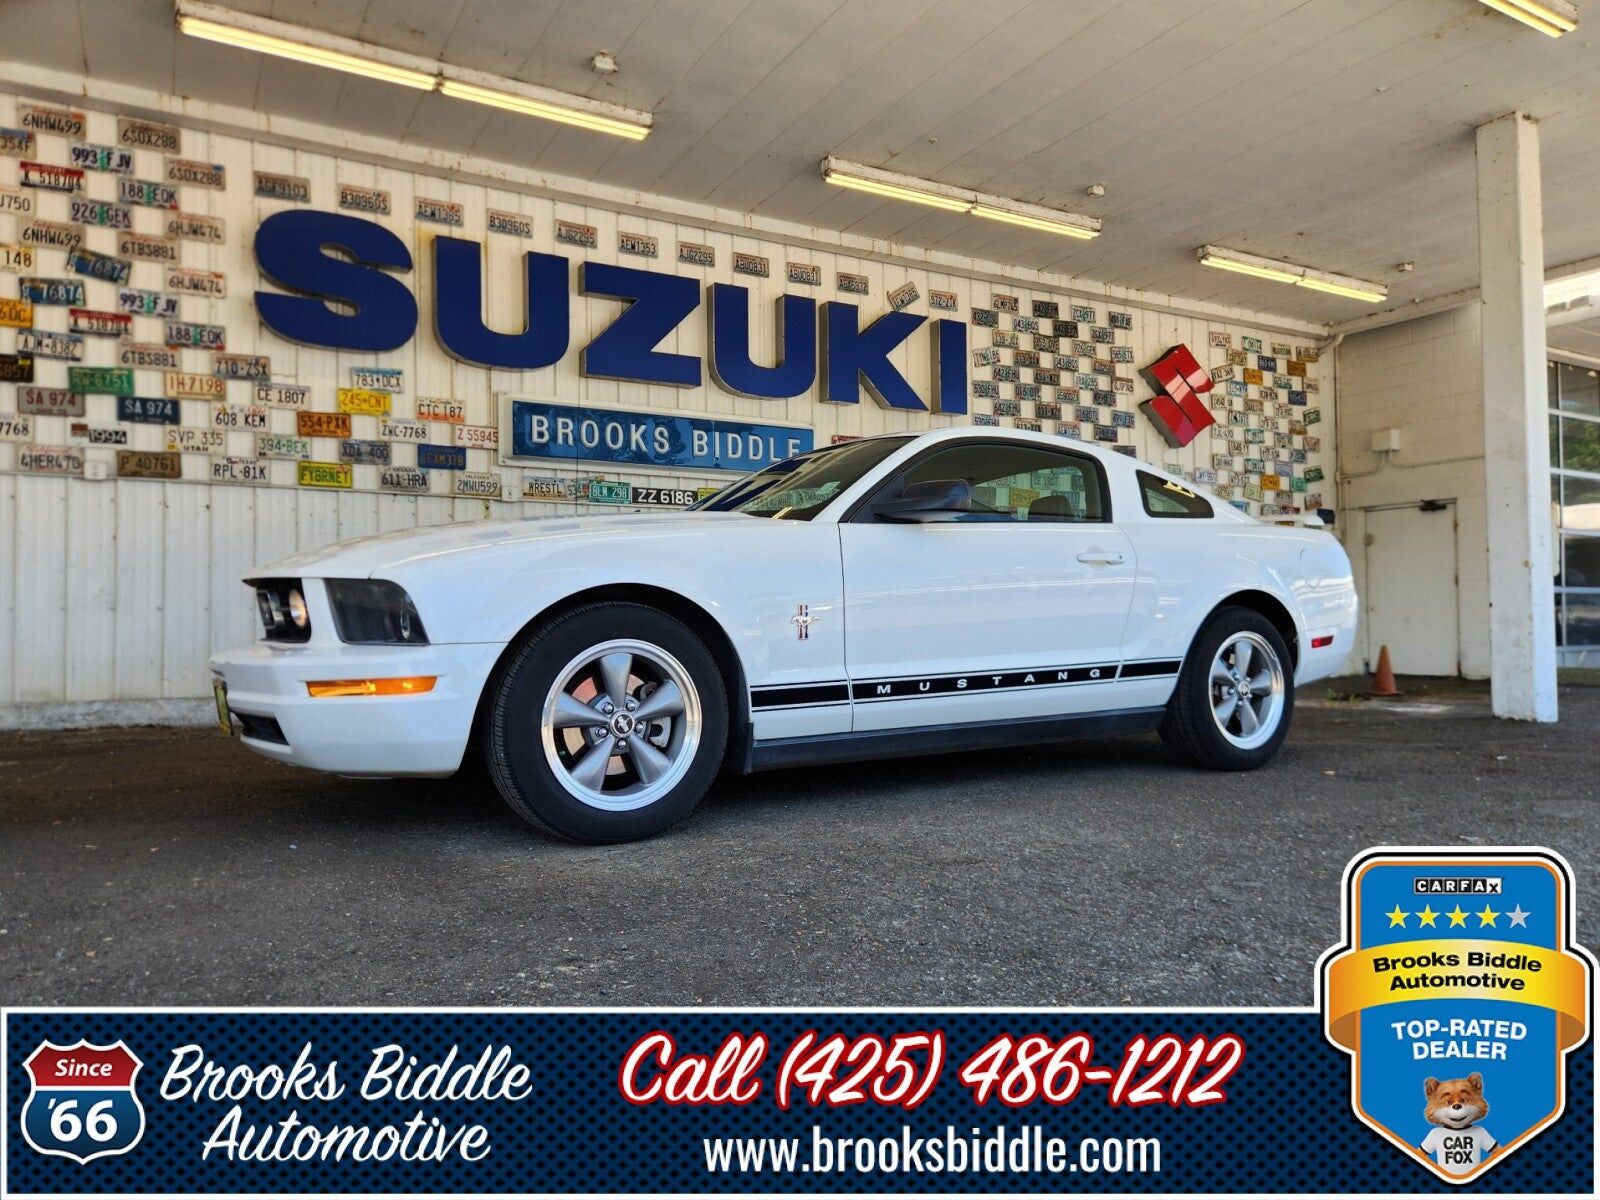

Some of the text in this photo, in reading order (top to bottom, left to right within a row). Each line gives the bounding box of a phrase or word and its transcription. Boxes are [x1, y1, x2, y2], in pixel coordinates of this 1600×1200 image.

[22, 113, 82, 135] 6NHW499
[72, 147, 98, 164] 993
[121, 181, 144, 199] 188
[71, 202, 131, 224] 926 GEK
[22, 226, 82, 247] 6NHW499
[5, 250, 32, 267] 148
[120, 293, 144, 309] 993
[254, 209, 968, 416] SUZUKI
[168, 325, 191, 341] 188
[26, 388, 76, 406] SA 974
[257, 388, 306, 404] CE 1807
[125, 400, 172, 416] SA 974
[418, 403, 462, 418] CTC 187
[215, 411, 267, 428] 608 KEM
[168, 429, 223, 446] SVP 335
[382, 425, 427, 439] ZWC-7768
[457, 428, 499, 443] Z 55945
[531, 414, 801, 463] BROOKS BIDDLE
[214, 463, 266, 479] RPL-81K
[528, 481, 562, 494] WRESTL
[612, 486, 627, 499] 298
[636, 488, 657, 503] ZZ
[660, 490, 693, 504] 6186
[876, 668, 1101, 694] MUSTANG
